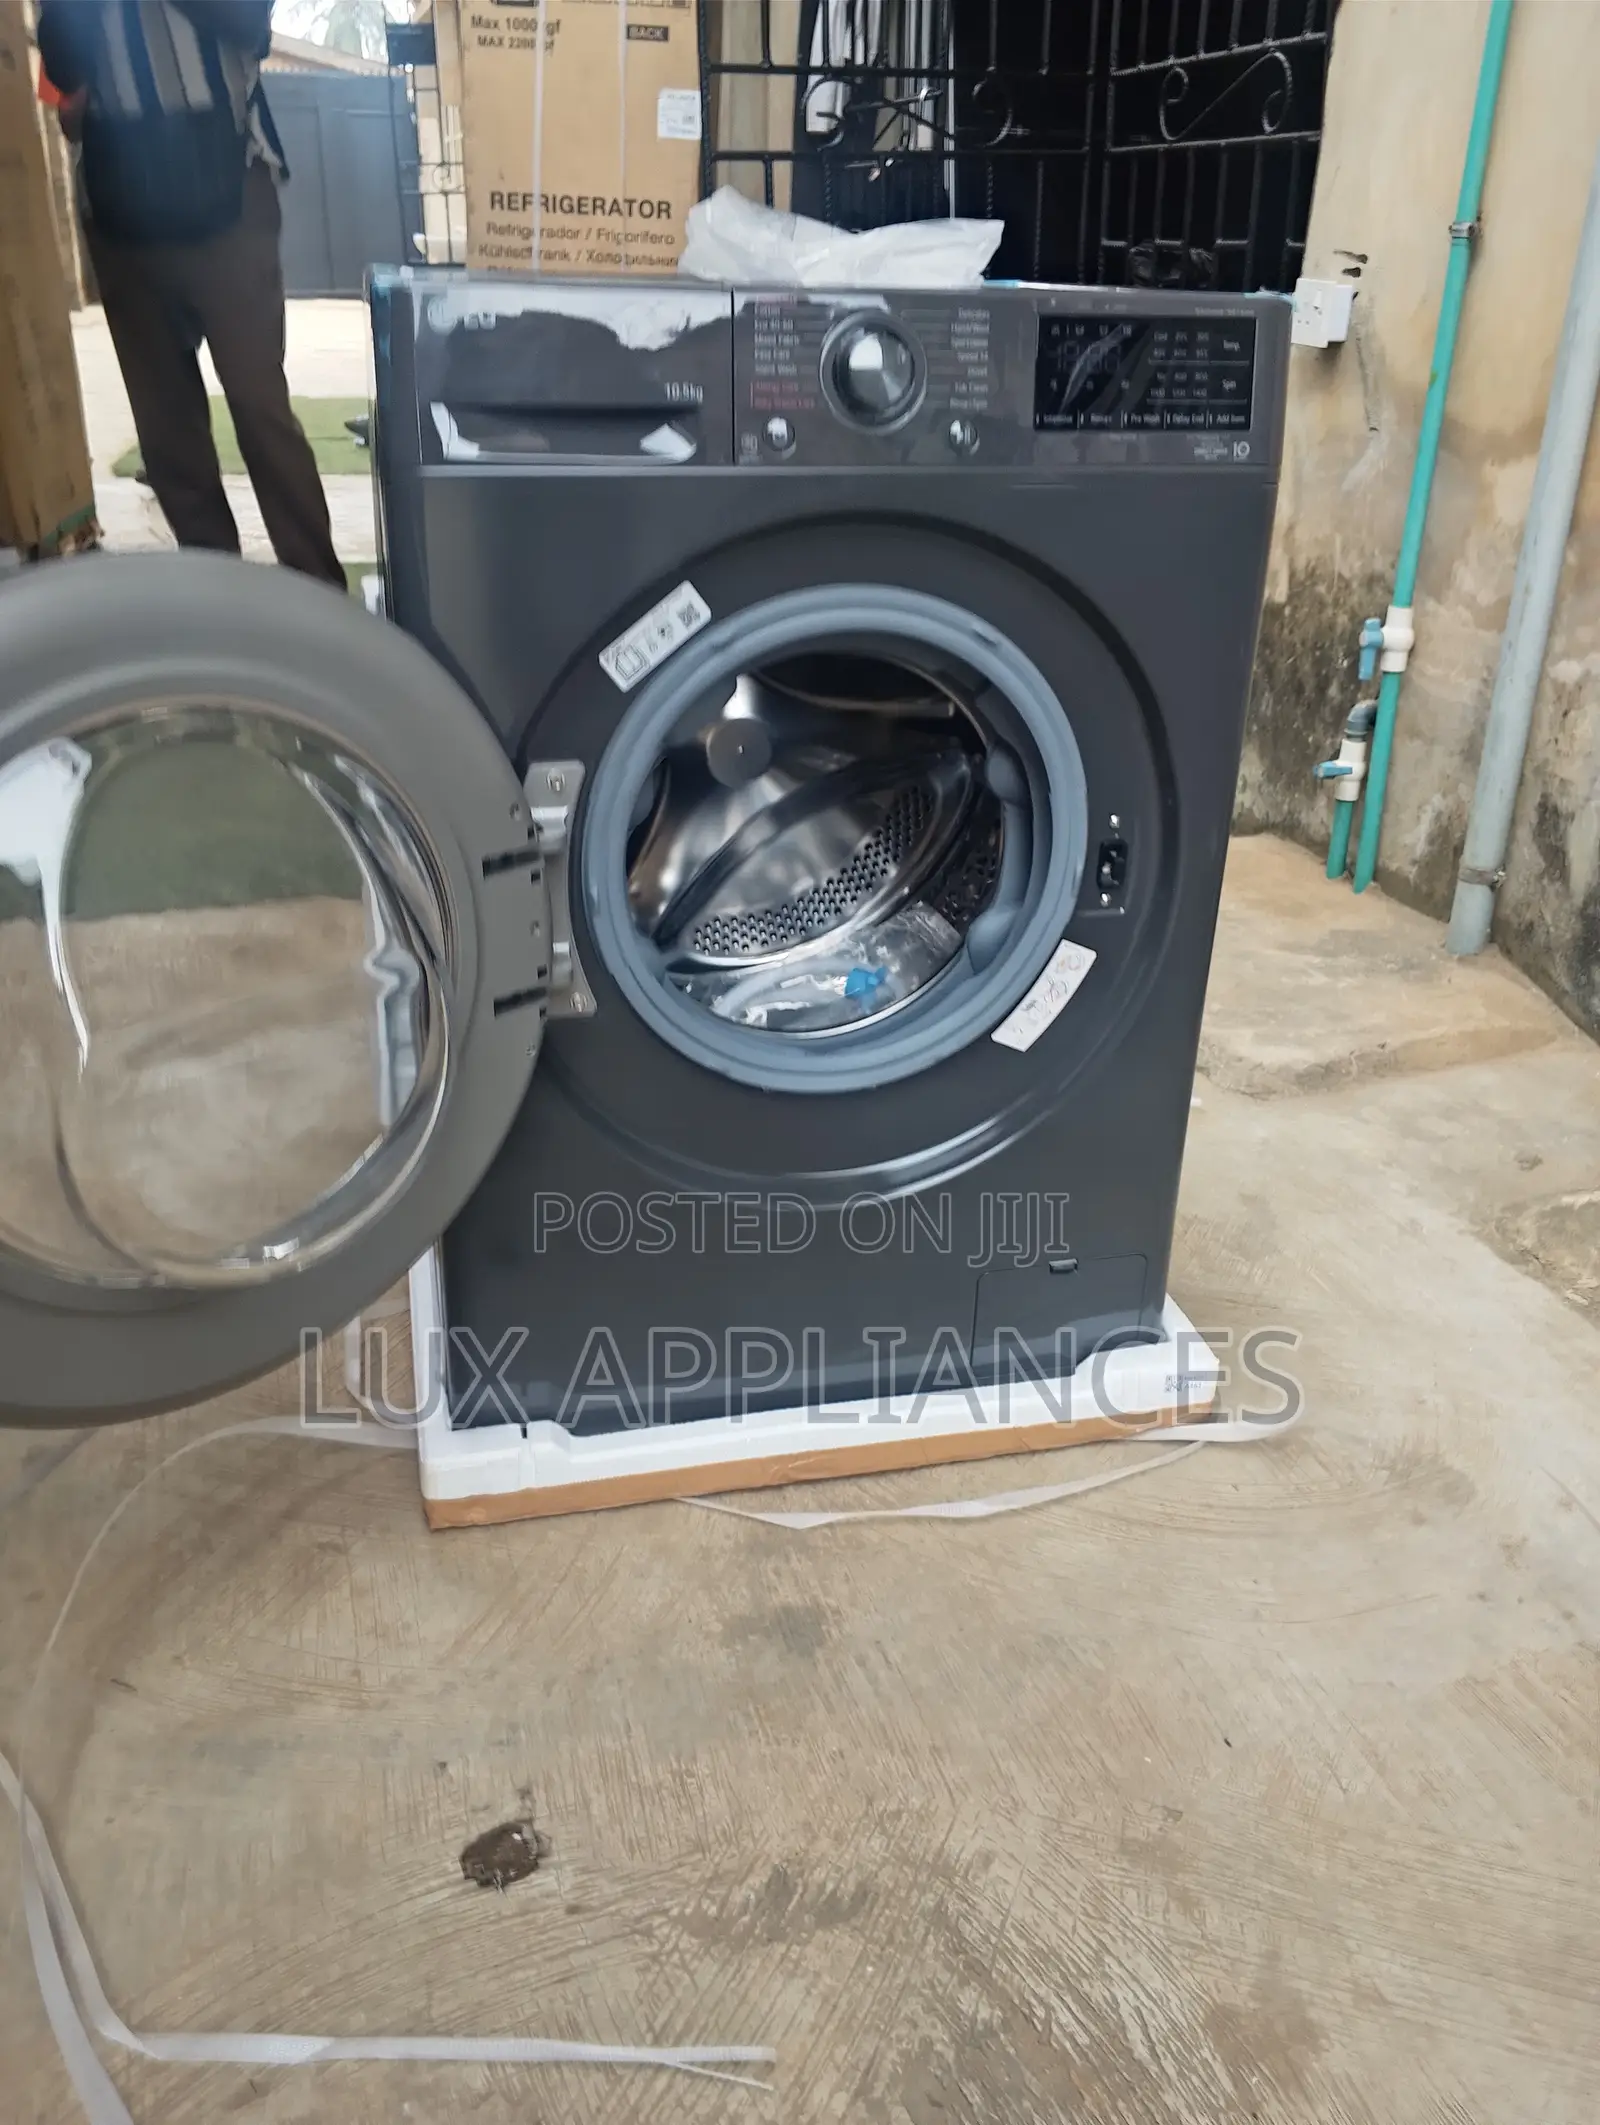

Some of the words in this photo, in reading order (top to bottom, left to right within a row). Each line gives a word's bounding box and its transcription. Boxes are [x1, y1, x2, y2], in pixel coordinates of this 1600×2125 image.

[629, 26, 664, 40] BACK
[477, 34, 505, 47] MAX
[490, 191, 671, 220] REFRIGERATOR
